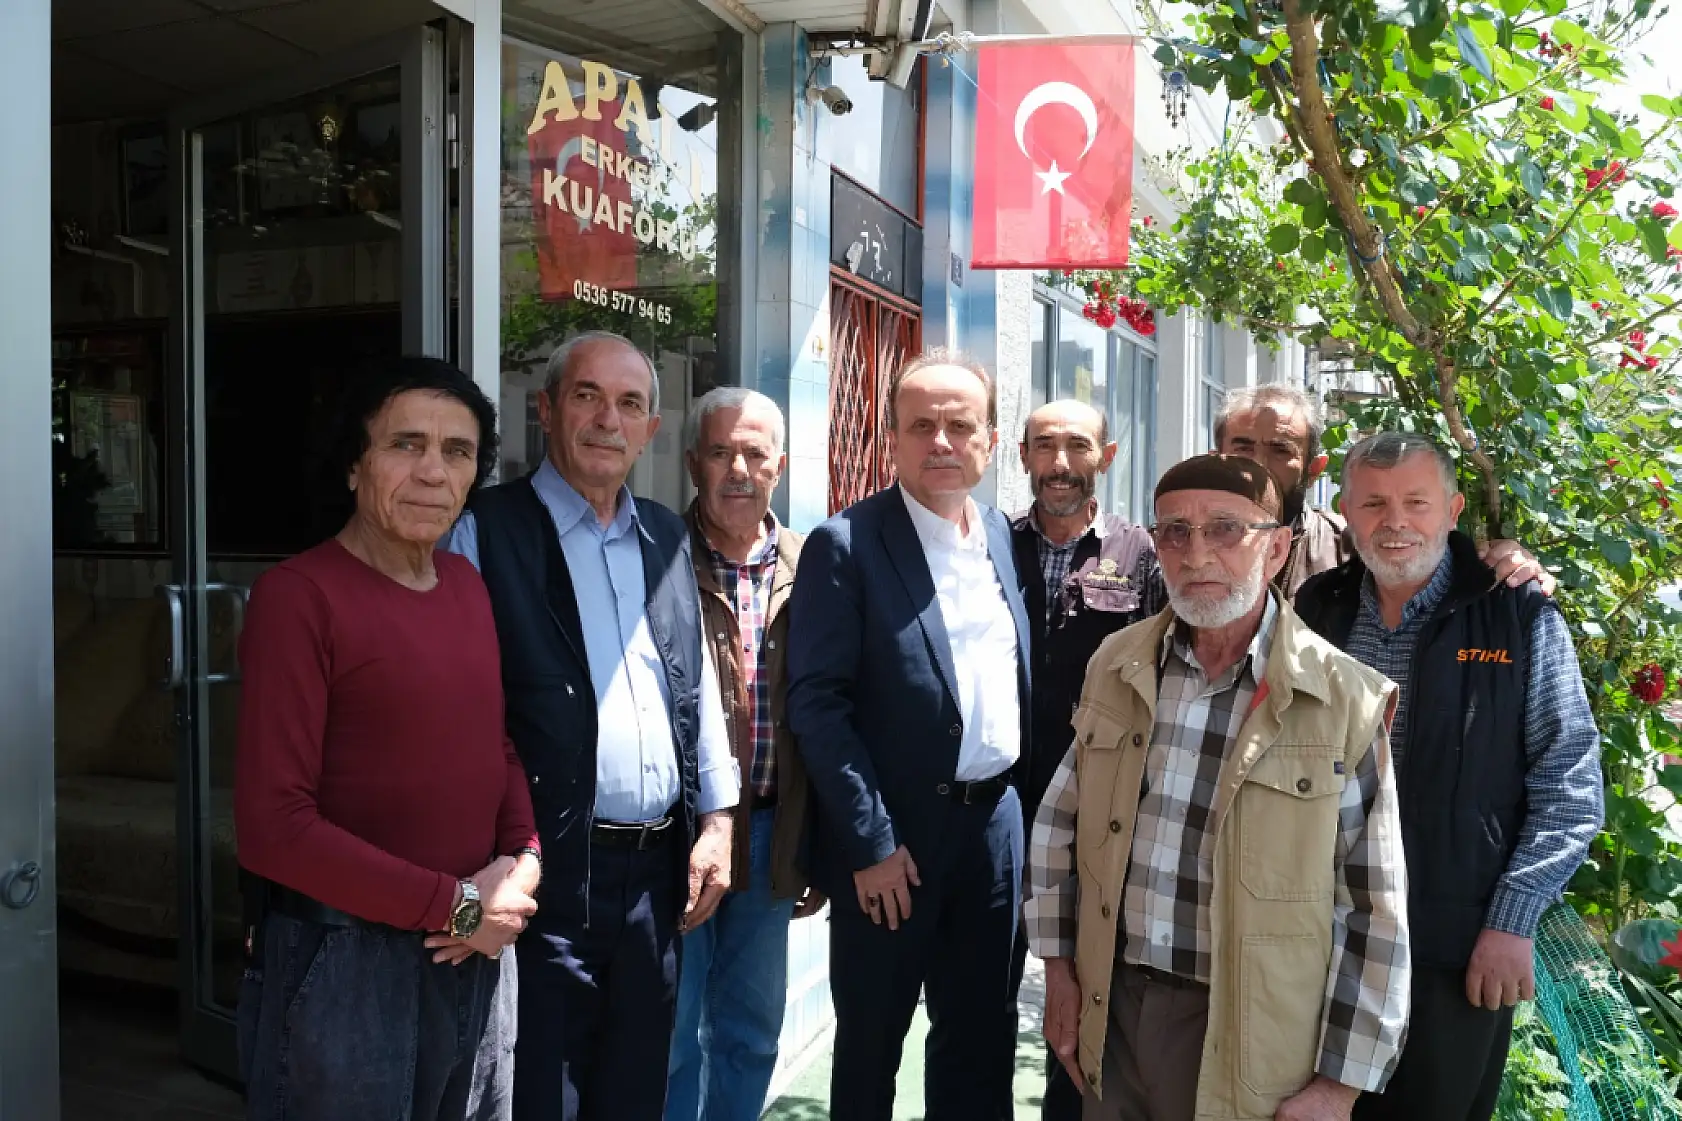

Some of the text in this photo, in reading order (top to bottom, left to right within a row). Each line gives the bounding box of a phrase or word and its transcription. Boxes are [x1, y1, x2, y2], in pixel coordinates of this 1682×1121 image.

[573, 279, 671, 325] 0536 577 94 65
[1456, 648, 1513, 664] STIHL
